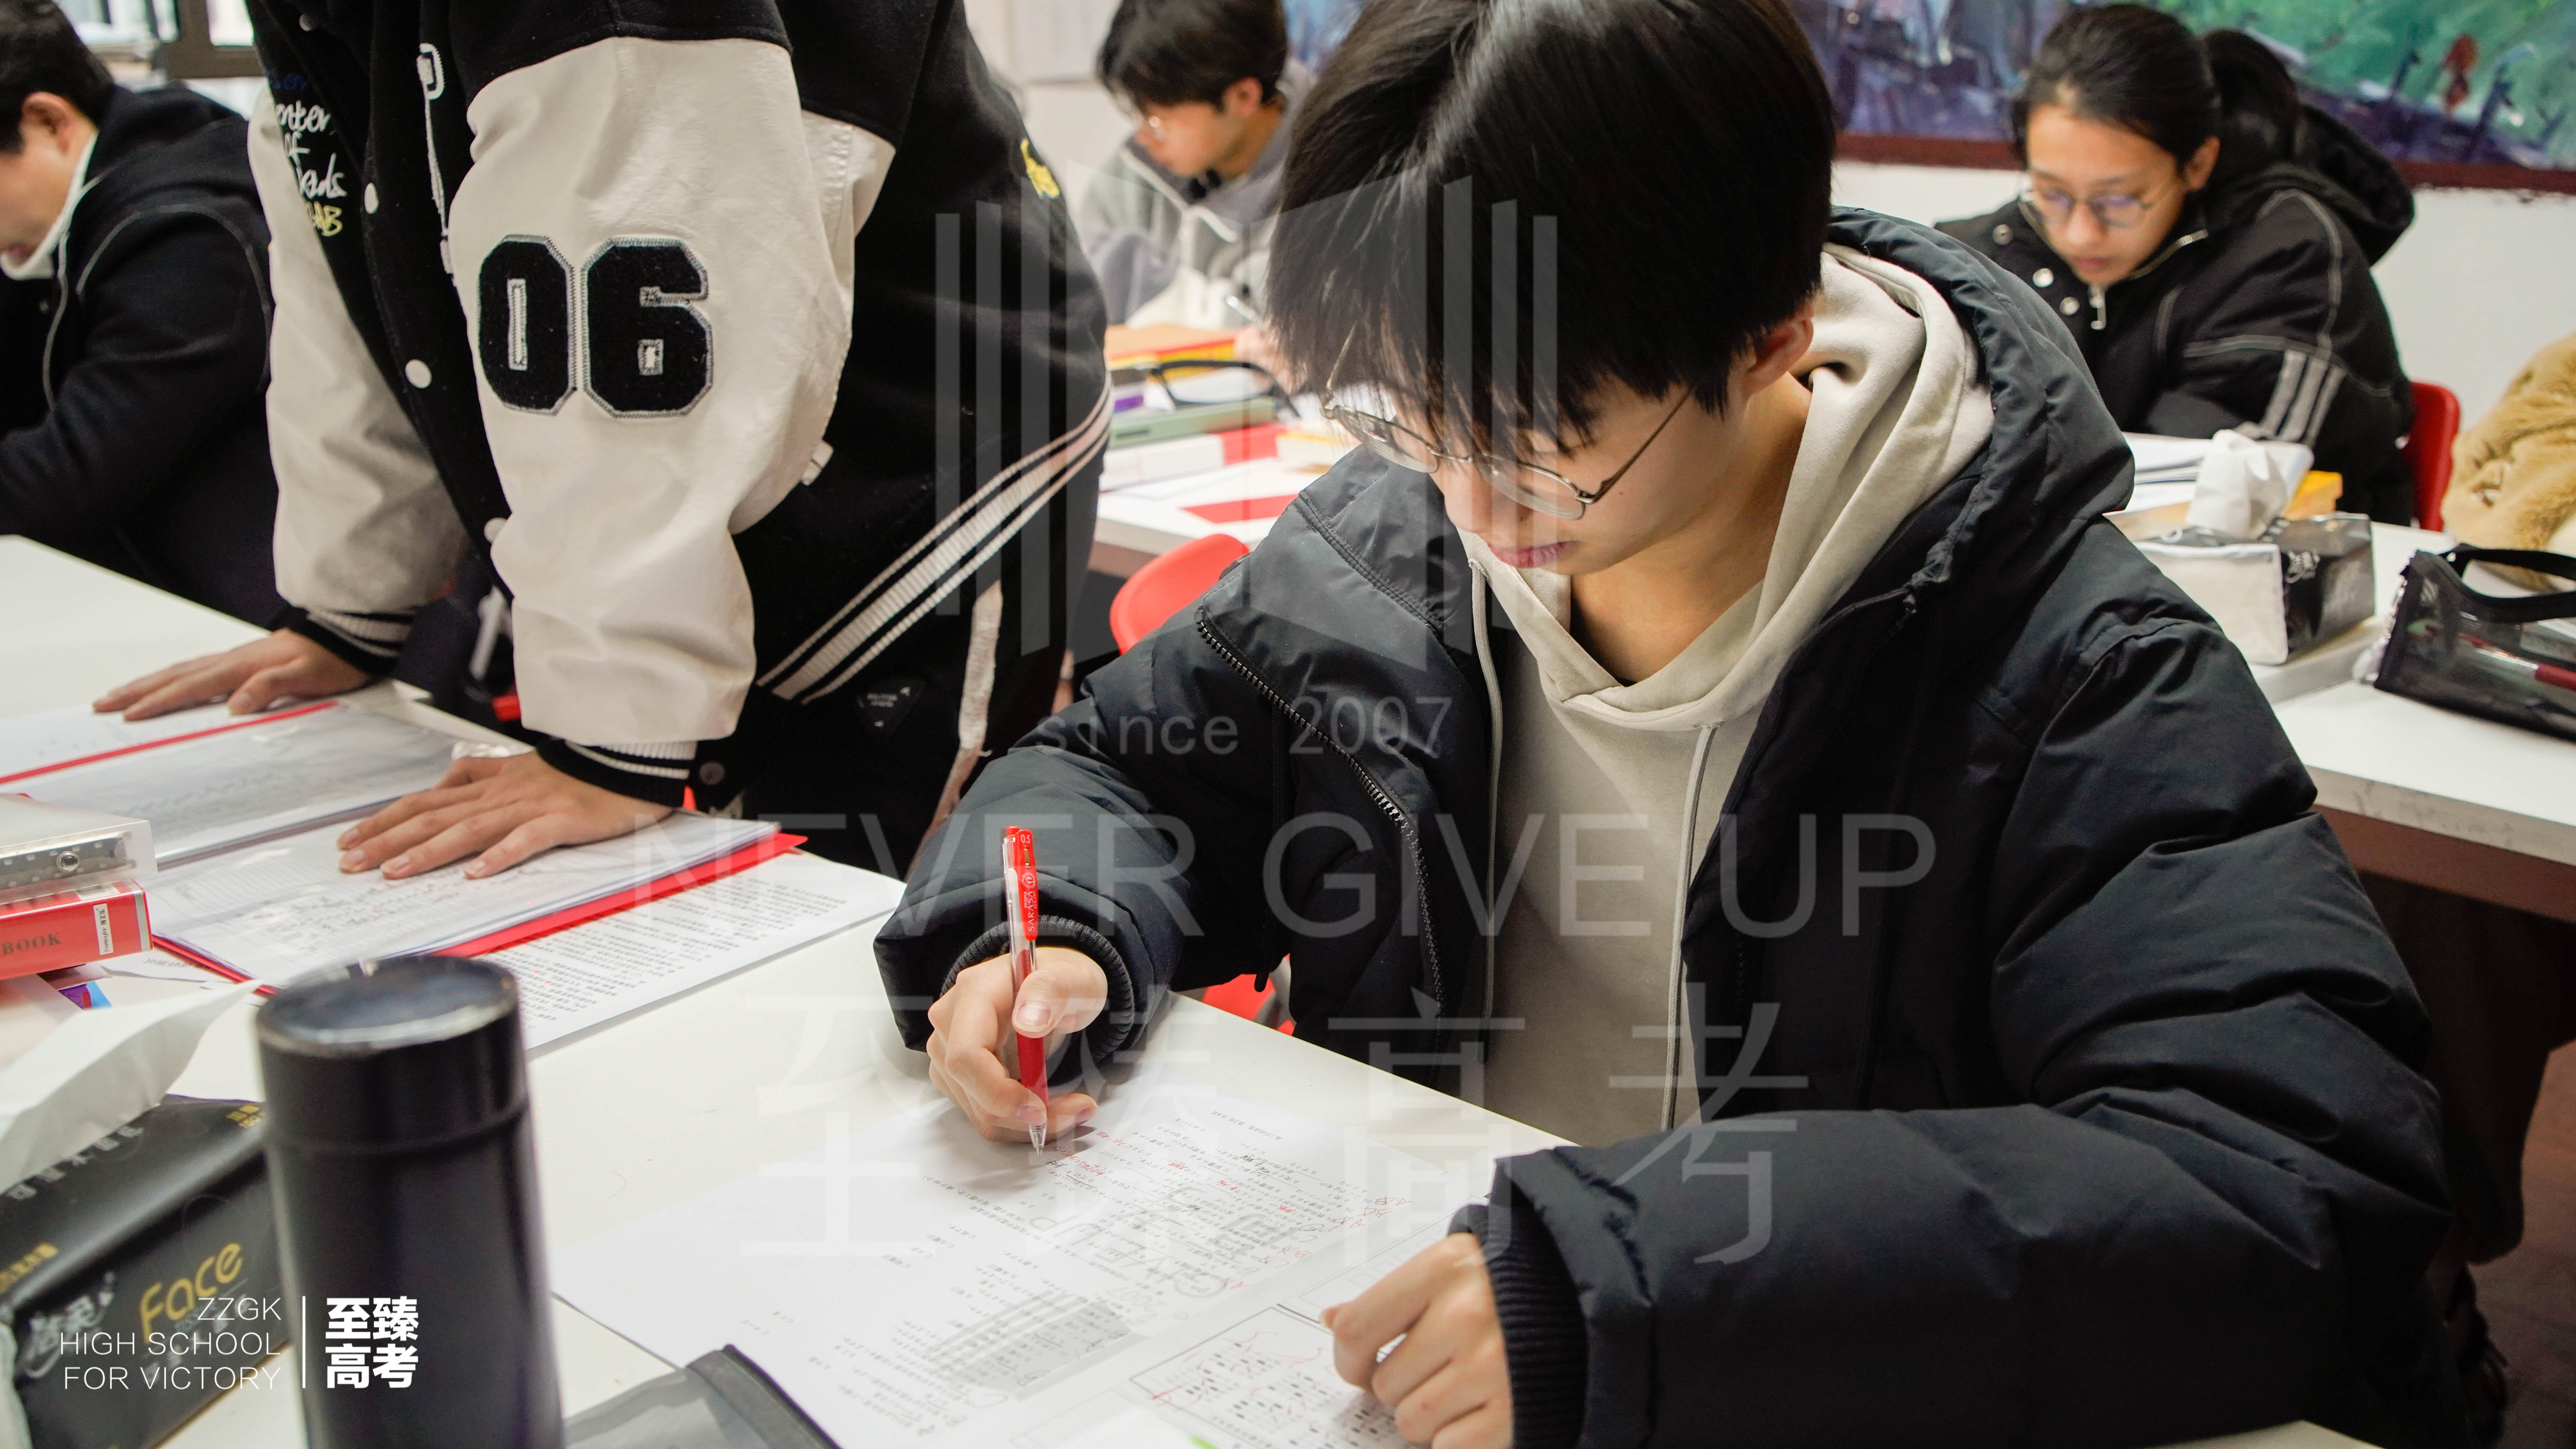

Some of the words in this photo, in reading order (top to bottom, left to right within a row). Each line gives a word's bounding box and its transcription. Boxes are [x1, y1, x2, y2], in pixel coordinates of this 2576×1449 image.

[479, 234, 713, 418] 06
[1021, 834, 1030, 843] 0.5
[1027, 891, 1035, 932] SARASA
[3, 933, 61, 955] BOOK
[139, 1242, 243, 1344] Face
